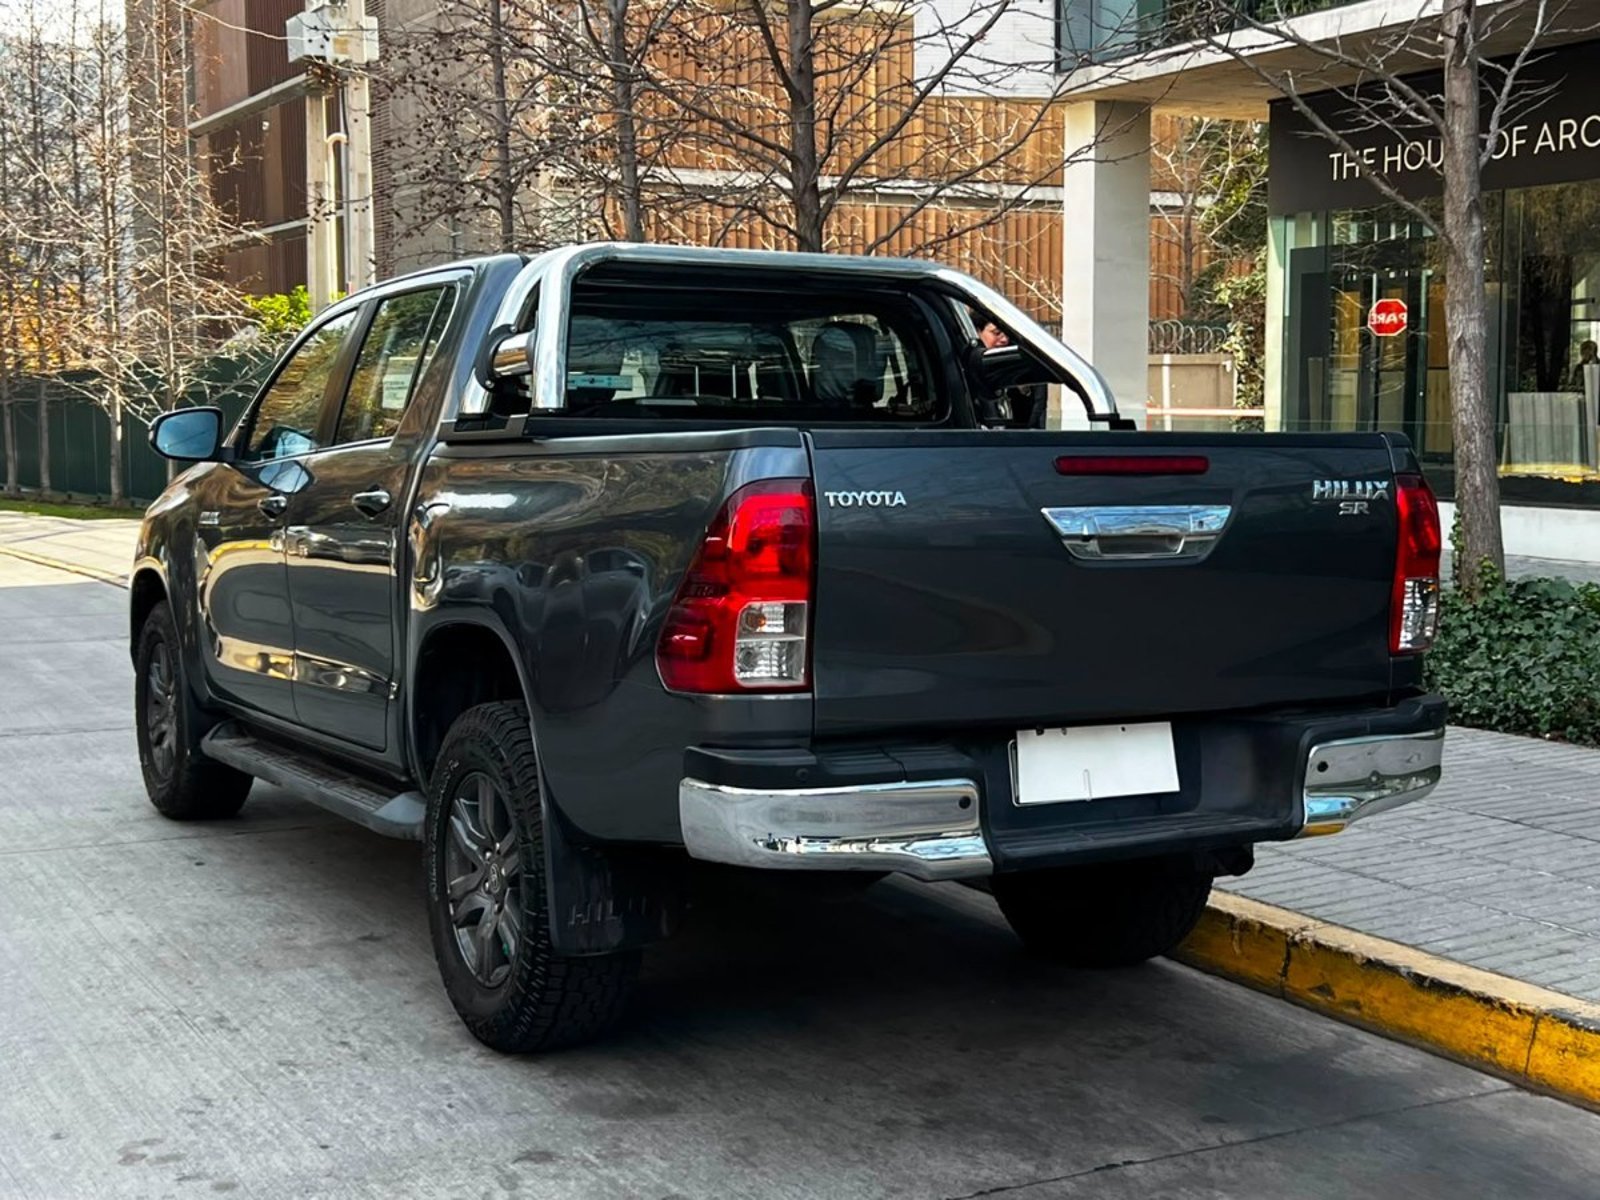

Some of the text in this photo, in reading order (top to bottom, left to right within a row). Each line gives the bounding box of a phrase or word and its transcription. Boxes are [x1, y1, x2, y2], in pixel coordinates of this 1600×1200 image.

[1329, 148, 1377, 181] THE
[1383, 138, 1445, 174] HOU
[1312, 480, 1390, 500] HILUX
[824, 491, 907, 508] TOYOTA
[1338, 501, 1371, 516] SR
